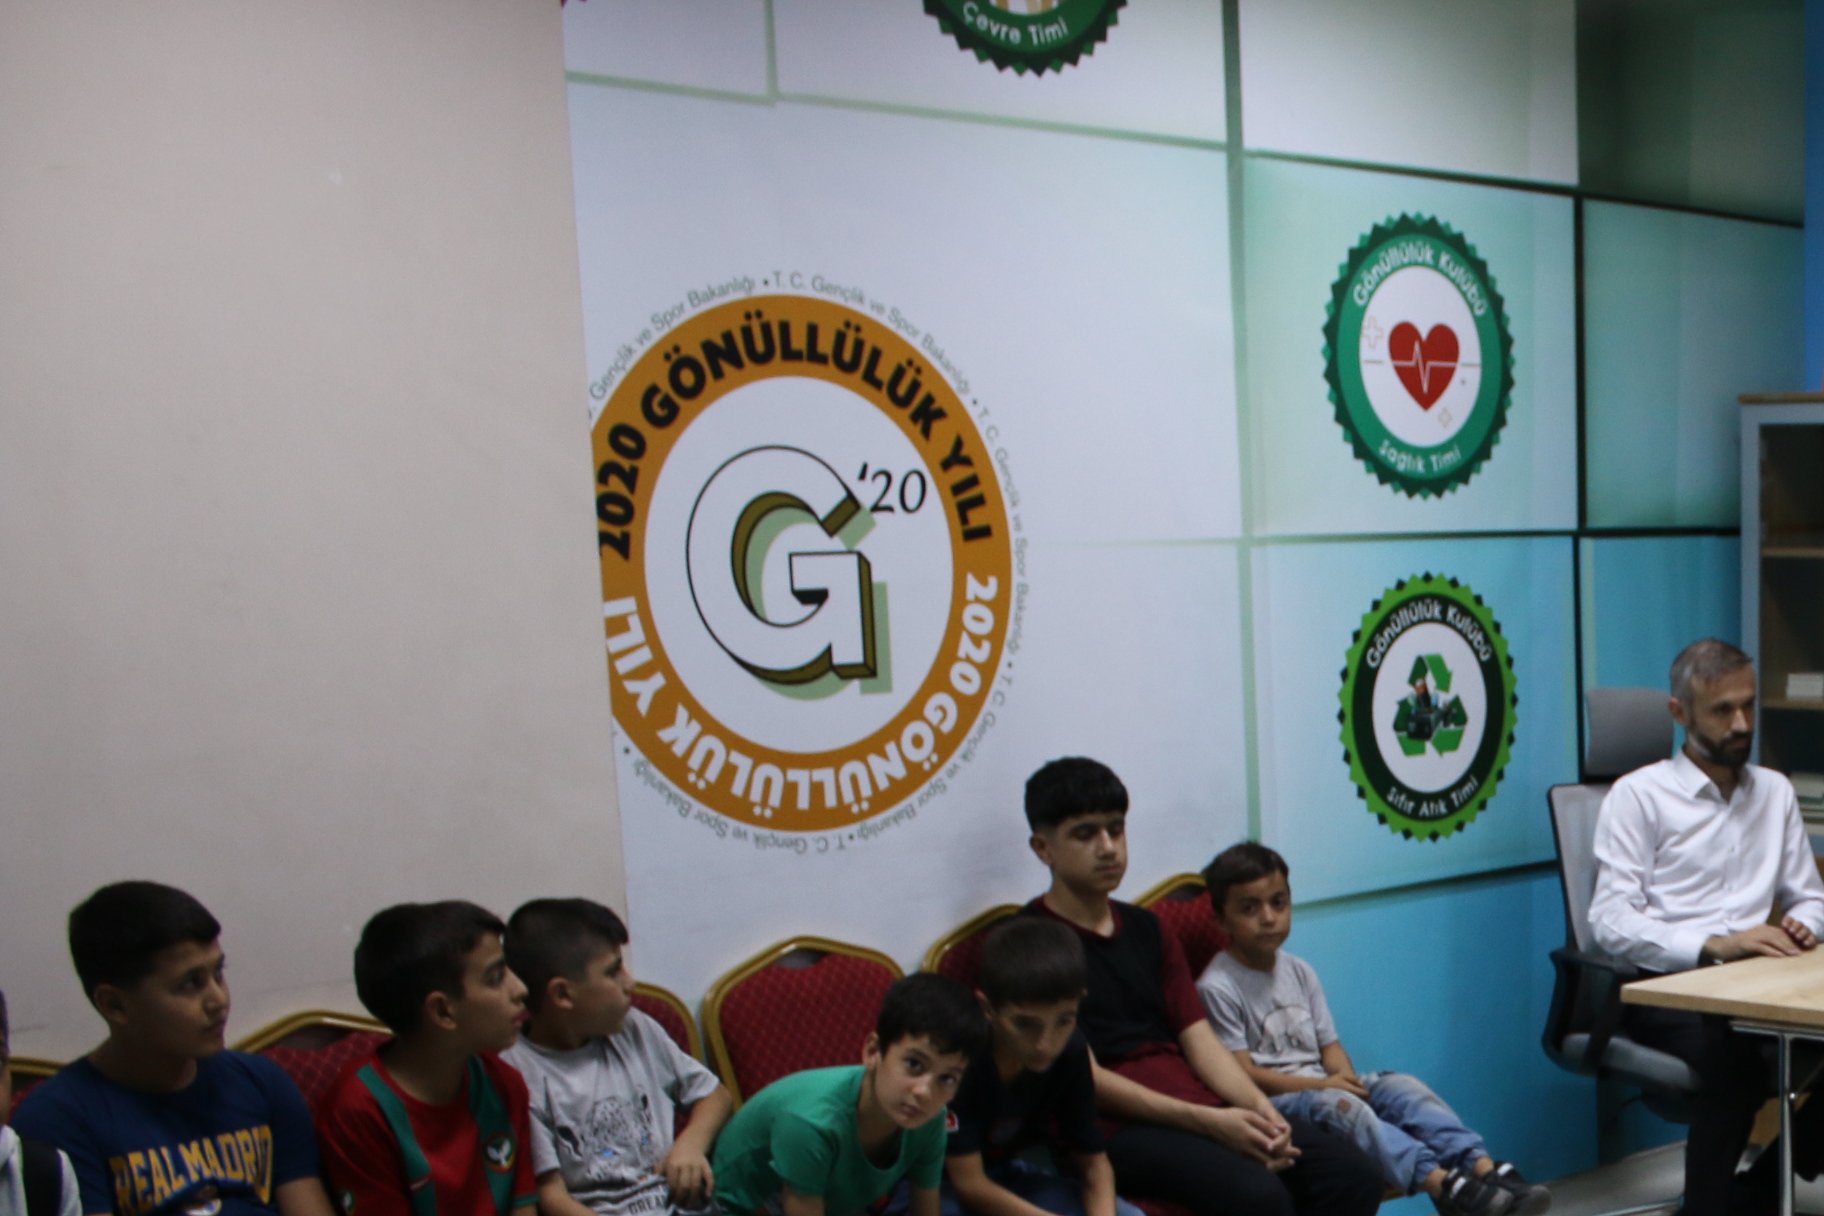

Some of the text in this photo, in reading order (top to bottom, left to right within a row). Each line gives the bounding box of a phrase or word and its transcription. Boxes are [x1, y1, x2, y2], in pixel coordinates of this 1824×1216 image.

[962, 1, 1070, 47] Çevre Timi
[811, 274, 865, 304] Gençlik
[869, 300, 886, 316] ve
[887, 306, 920, 338] Spor
[1353, 242, 1488, 317] Gönüllülük Kulübü
[589, 343, 635, 401] Gençlik
[635, 328, 652, 346] ve
[651, 301, 685, 332] Spor
[596, 309, 993, 561] 2020 GÖNÜLLÜLÜK YILI
[1378, 440, 1462, 472] Sağlık Timi
[1366, 599, 1494, 668] Gönüllülük Kulübü
[603, 572, 998, 819] 2020 GÖNÜLLÜLÜK YILI
[1386, 775, 1480, 818] Sıfır Atık Timi
[694, 811, 729, 838] Spor
[731, 825, 749, 841] ve
[753, 832, 808, 854] Gençlik
